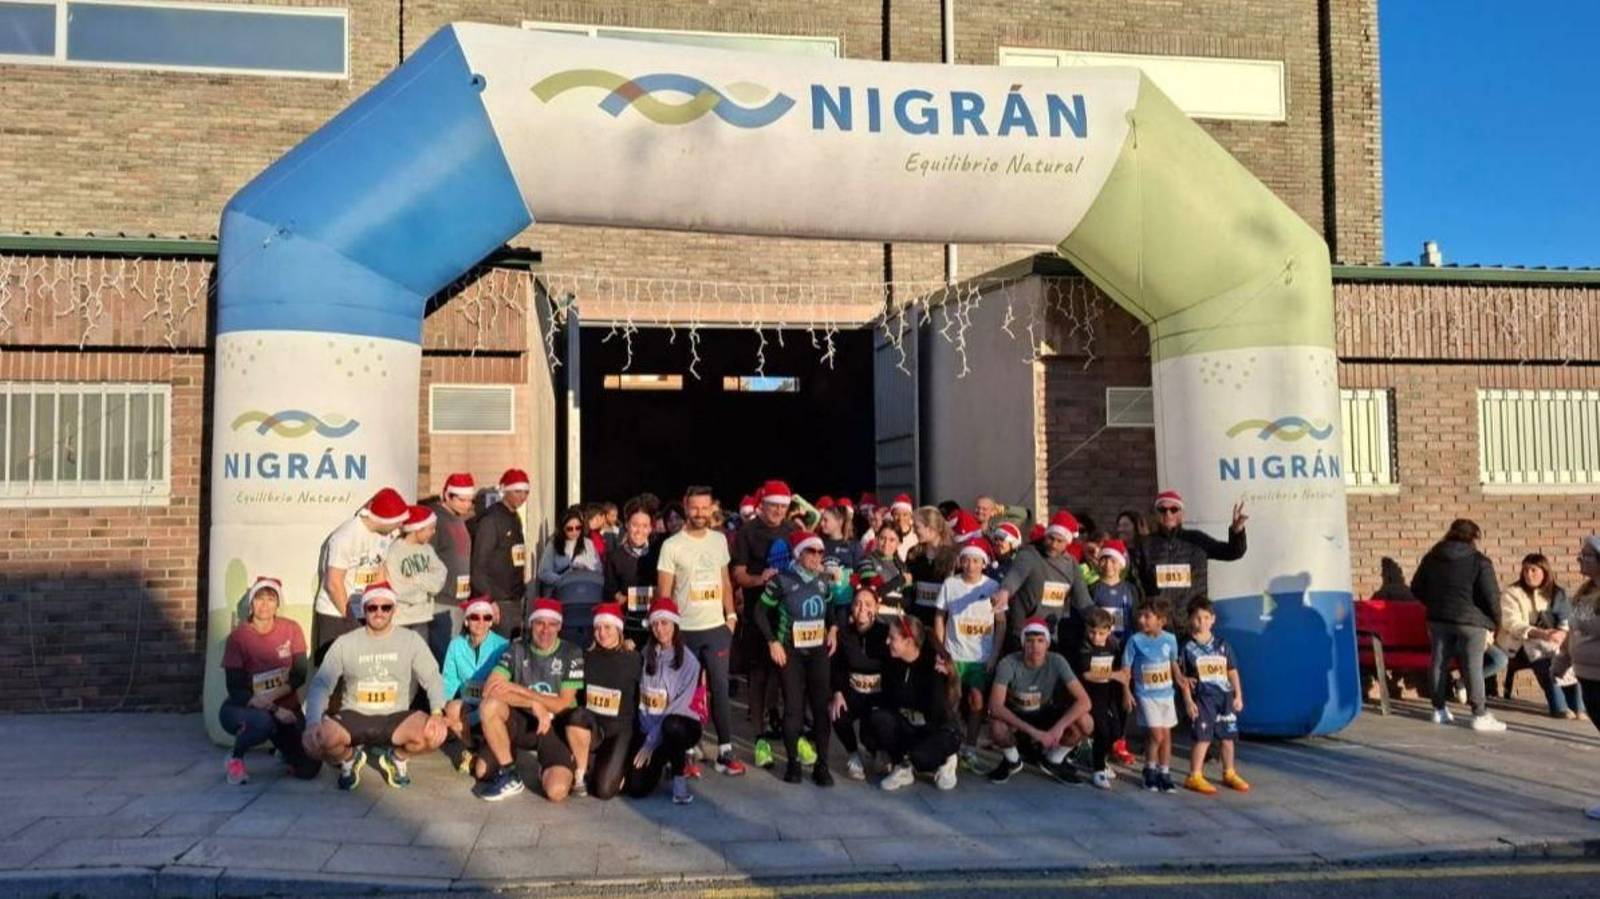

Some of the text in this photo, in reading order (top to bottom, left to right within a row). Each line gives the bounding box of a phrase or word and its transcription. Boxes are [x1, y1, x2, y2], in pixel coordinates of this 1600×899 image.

[810, 83, 1088, 139] NIGRÁN
[905, 152, 1085, 176] Equilibrio Natural
[224, 447, 367, 480] NIGRÁN
[1219, 449, 1340, 481] NIGRÁN
[236, 491, 351, 505] Equilibrio Natural
